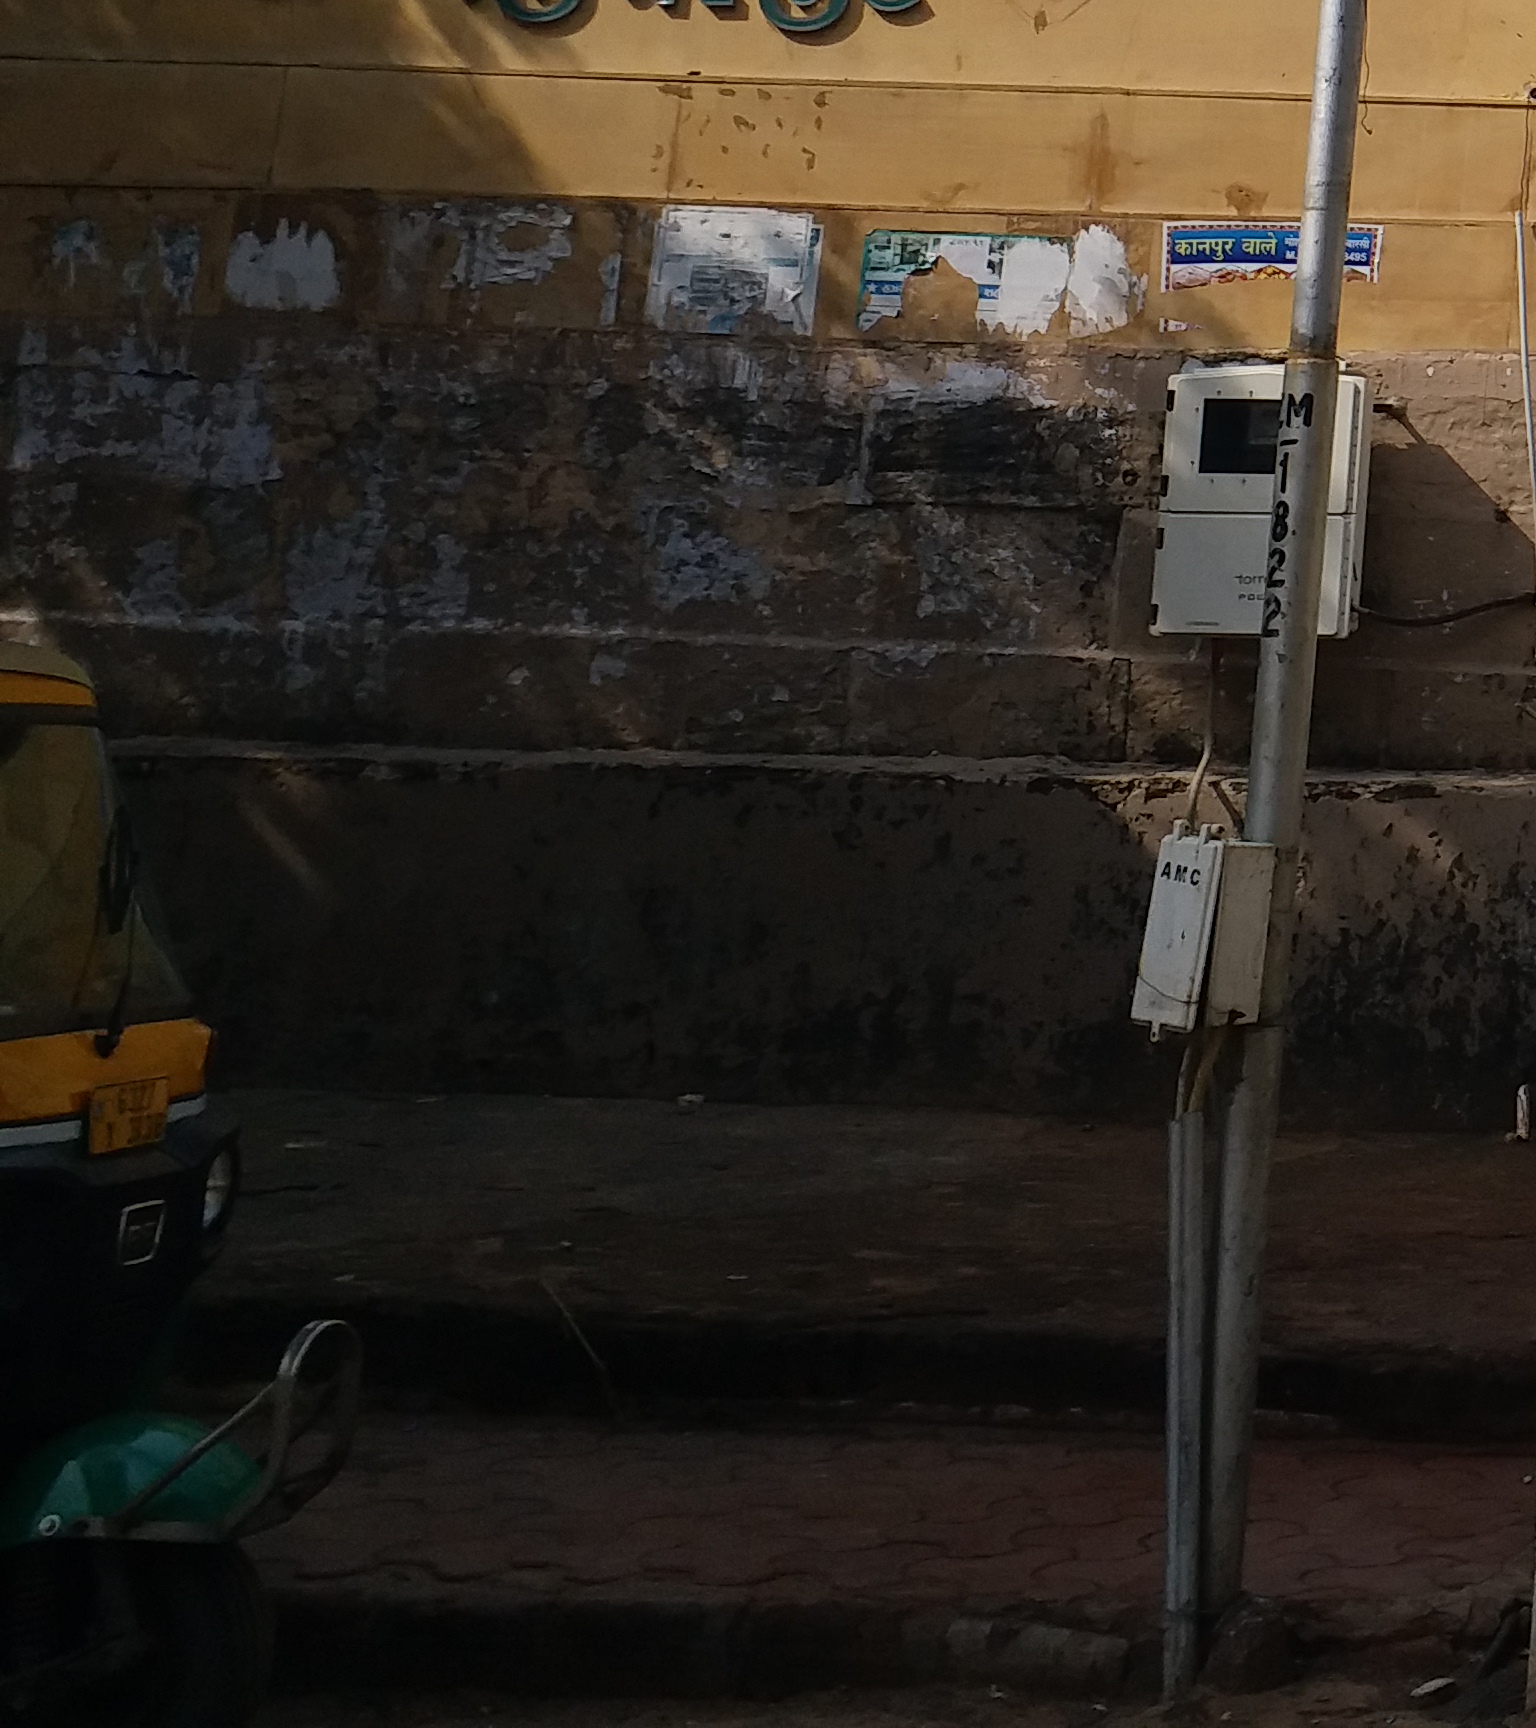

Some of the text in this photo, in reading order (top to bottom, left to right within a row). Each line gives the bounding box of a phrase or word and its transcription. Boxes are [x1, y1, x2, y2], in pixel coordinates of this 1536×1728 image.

[1174, 232, 1278, 261] कानपुर वाले
[1261, 392, 1314, 637] M-1822
[1161, 860, 1201, 886] AMC
